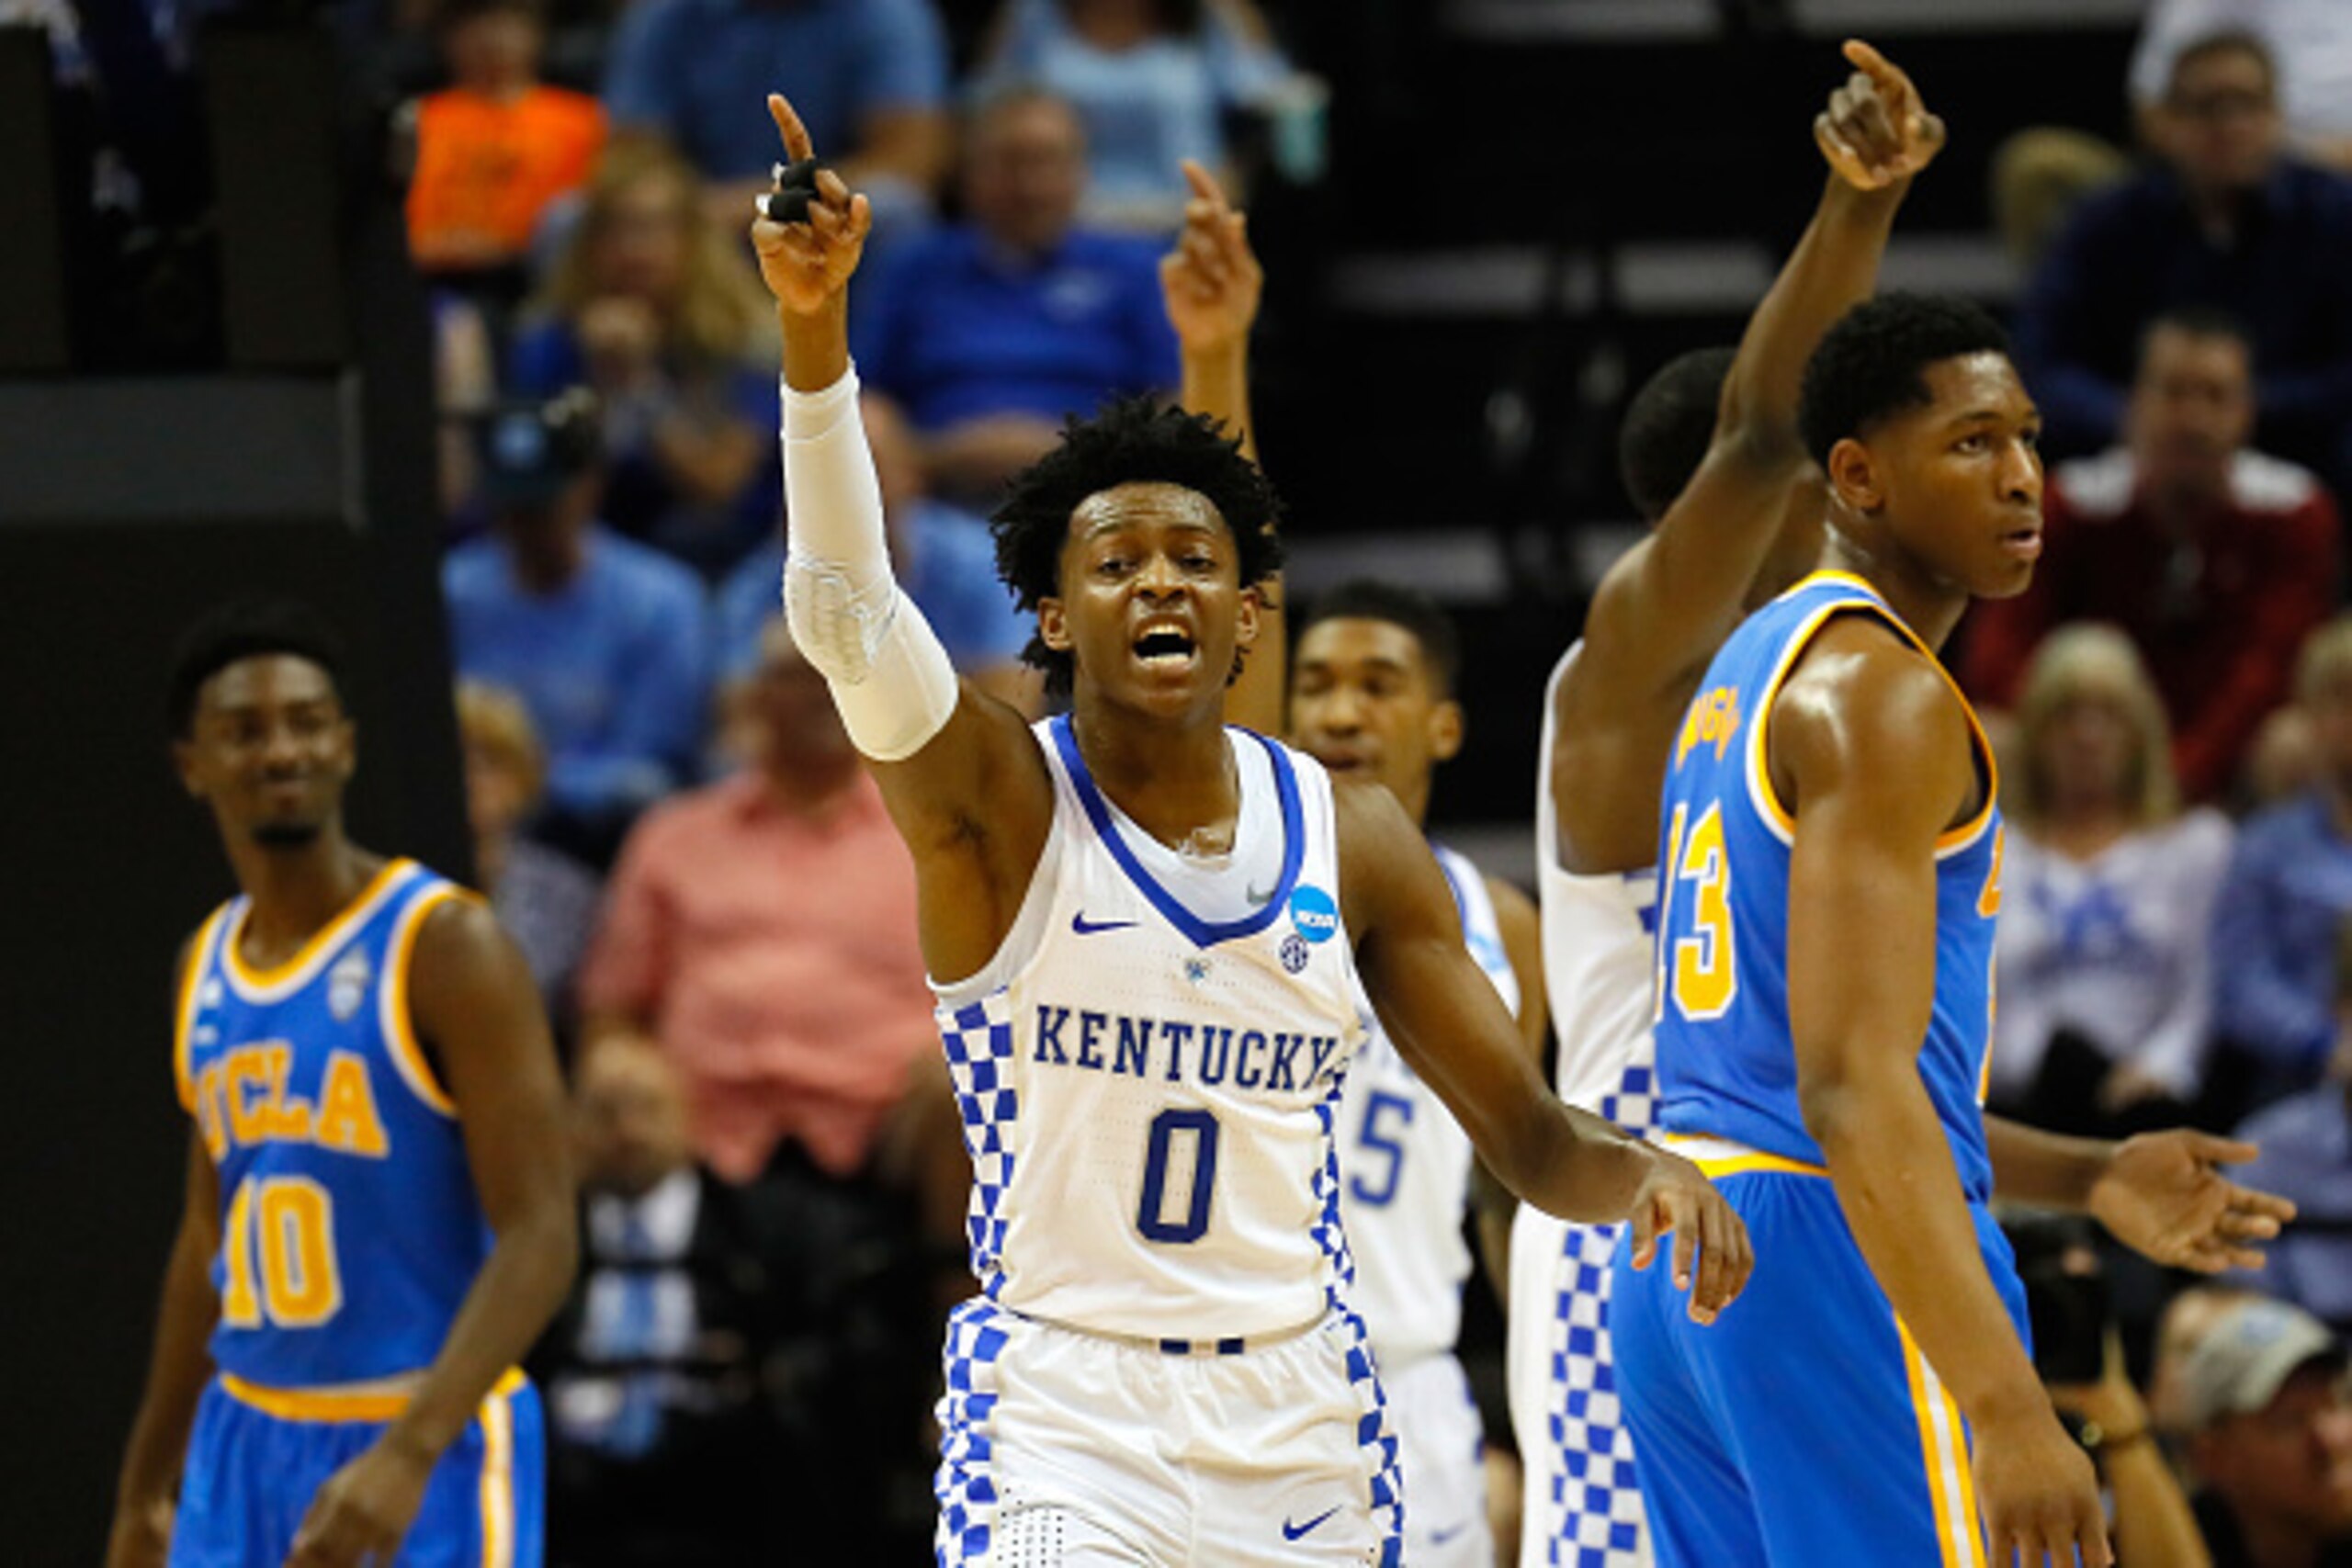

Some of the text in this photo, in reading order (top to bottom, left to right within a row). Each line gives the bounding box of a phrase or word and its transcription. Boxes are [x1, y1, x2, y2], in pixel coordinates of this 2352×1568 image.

[1034, 1005, 1337, 1091] KENTUCKY
[1136, 1108, 1219, 1244] 0
[1350, 1089, 1413, 1208] 5
[221, 1172, 343, 1329] 10
